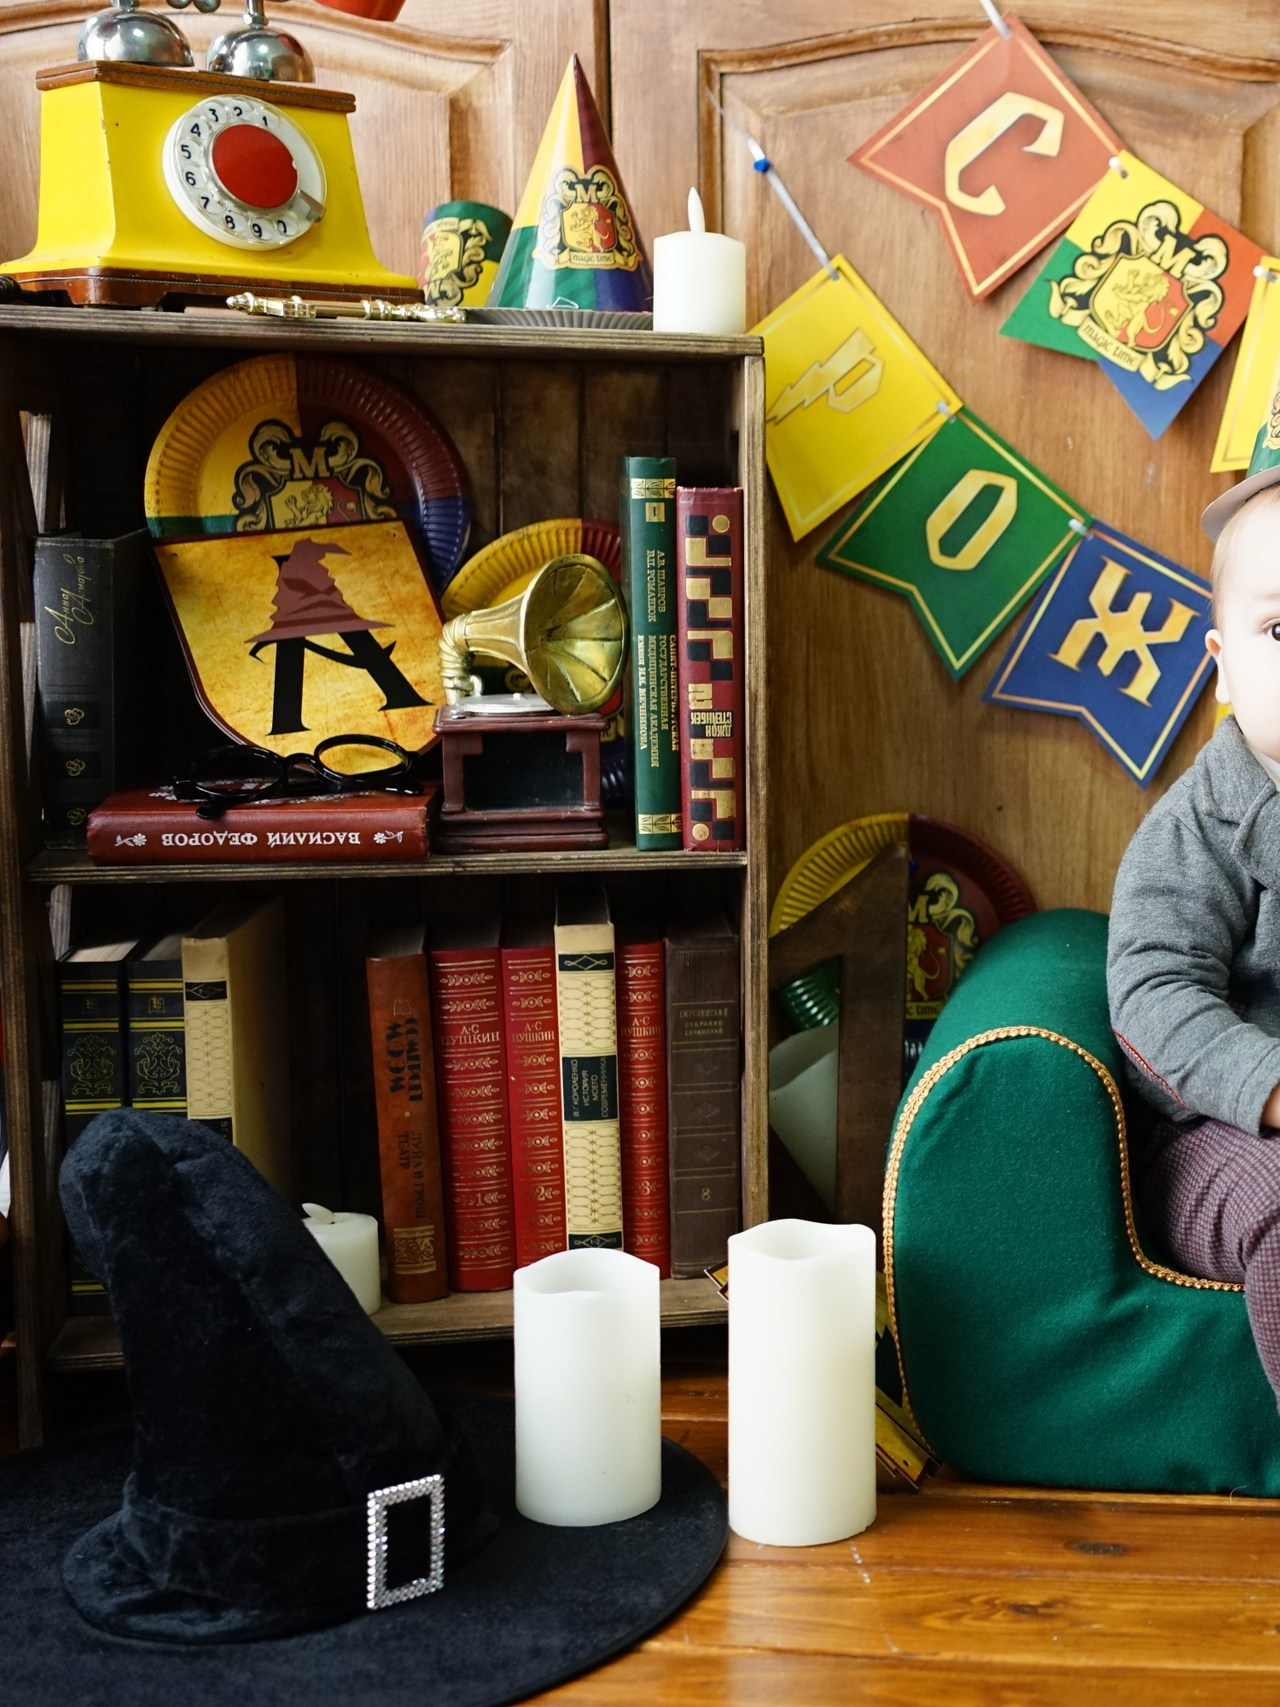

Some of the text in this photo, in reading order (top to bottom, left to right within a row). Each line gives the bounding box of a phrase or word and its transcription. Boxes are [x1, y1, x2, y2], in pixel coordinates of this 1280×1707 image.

[209, 108, 219, 122] 3
[233, 106, 243, 117] 2
[262, 116, 269, 127] 1
[190, 123, 201, 137] 4
[181, 144, 192, 159] 5
[185, 171, 197, 186] 6
[575, 184, 599, 203] M
[201, 196, 210, 209] 7
[225, 215, 236, 230] 8
[252, 223, 263, 238] 9
[1150, 234, 1197, 279] M
[291, 447, 331, 479] M
[162, 831, 361, 847] ВАСИЛИЙ ФЕДОРОВ
[441, 1032, 501, 1045] ПУШКИН
[512, 1030, 555, 1042] ПУШКИН
[620, 1025, 662, 1037] ПУШКИН
[535, 1186, 546, 1201] 2
